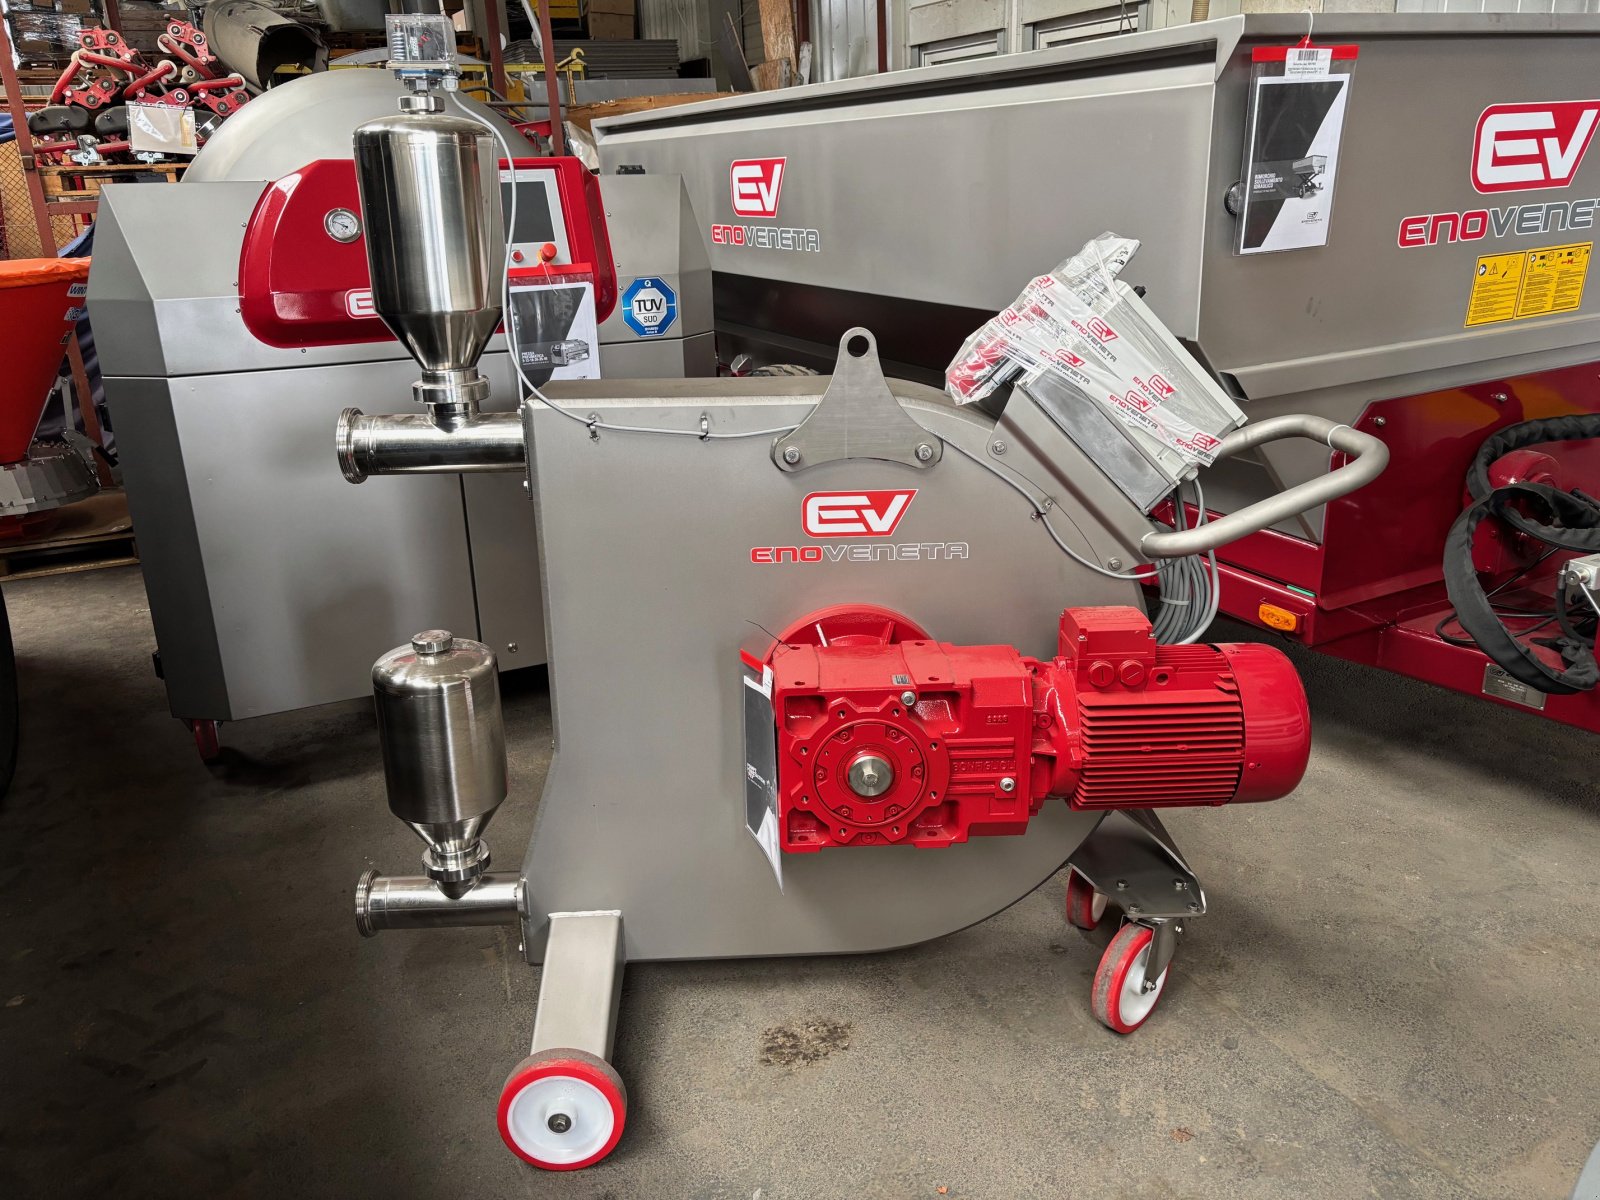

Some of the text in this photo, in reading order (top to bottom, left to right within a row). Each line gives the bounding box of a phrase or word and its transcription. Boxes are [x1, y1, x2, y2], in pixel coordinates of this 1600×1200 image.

[1477, 109, 1599, 185] EV
[732, 163, 783, 212] EV
[711, 224, 820, 252] ENOVENETA
[1398, 198, 1600, 248] ENOVENE
[635, 298, 663, 312] TÜV
[1071, 320, 1118, 363] ENOVENETA
[1087, 316, 1119, 343] EV
[1109, 394, 1159, 430] ENOVENETA
[1125, 390, 1152, 413] EV
[807, 494, 910, 534] EV
[751, 542, 969, 563] ENOVENETA
